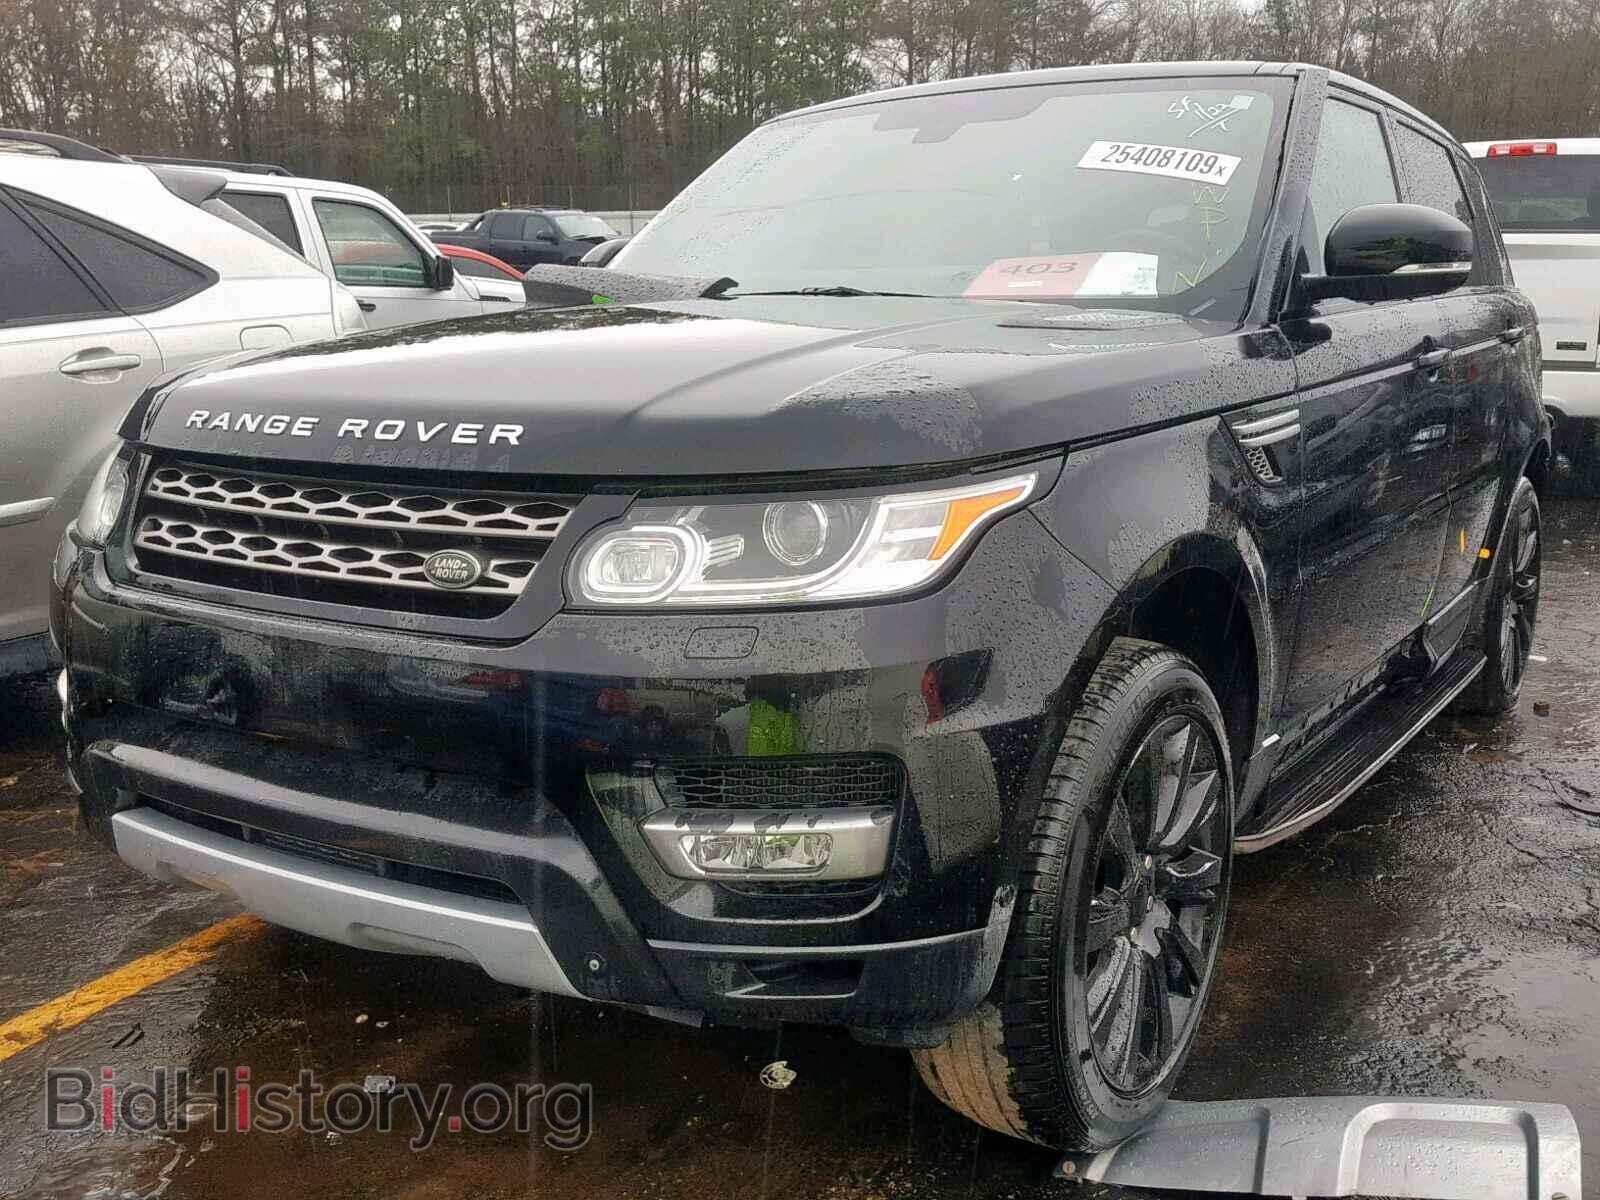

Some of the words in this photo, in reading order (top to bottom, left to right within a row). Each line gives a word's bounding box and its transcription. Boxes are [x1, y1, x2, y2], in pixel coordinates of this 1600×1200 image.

[1000, 261, 1078, 275] 403
[185, 410, 320, 437] RANGE
[337, 418, 525, 446] ROVER
